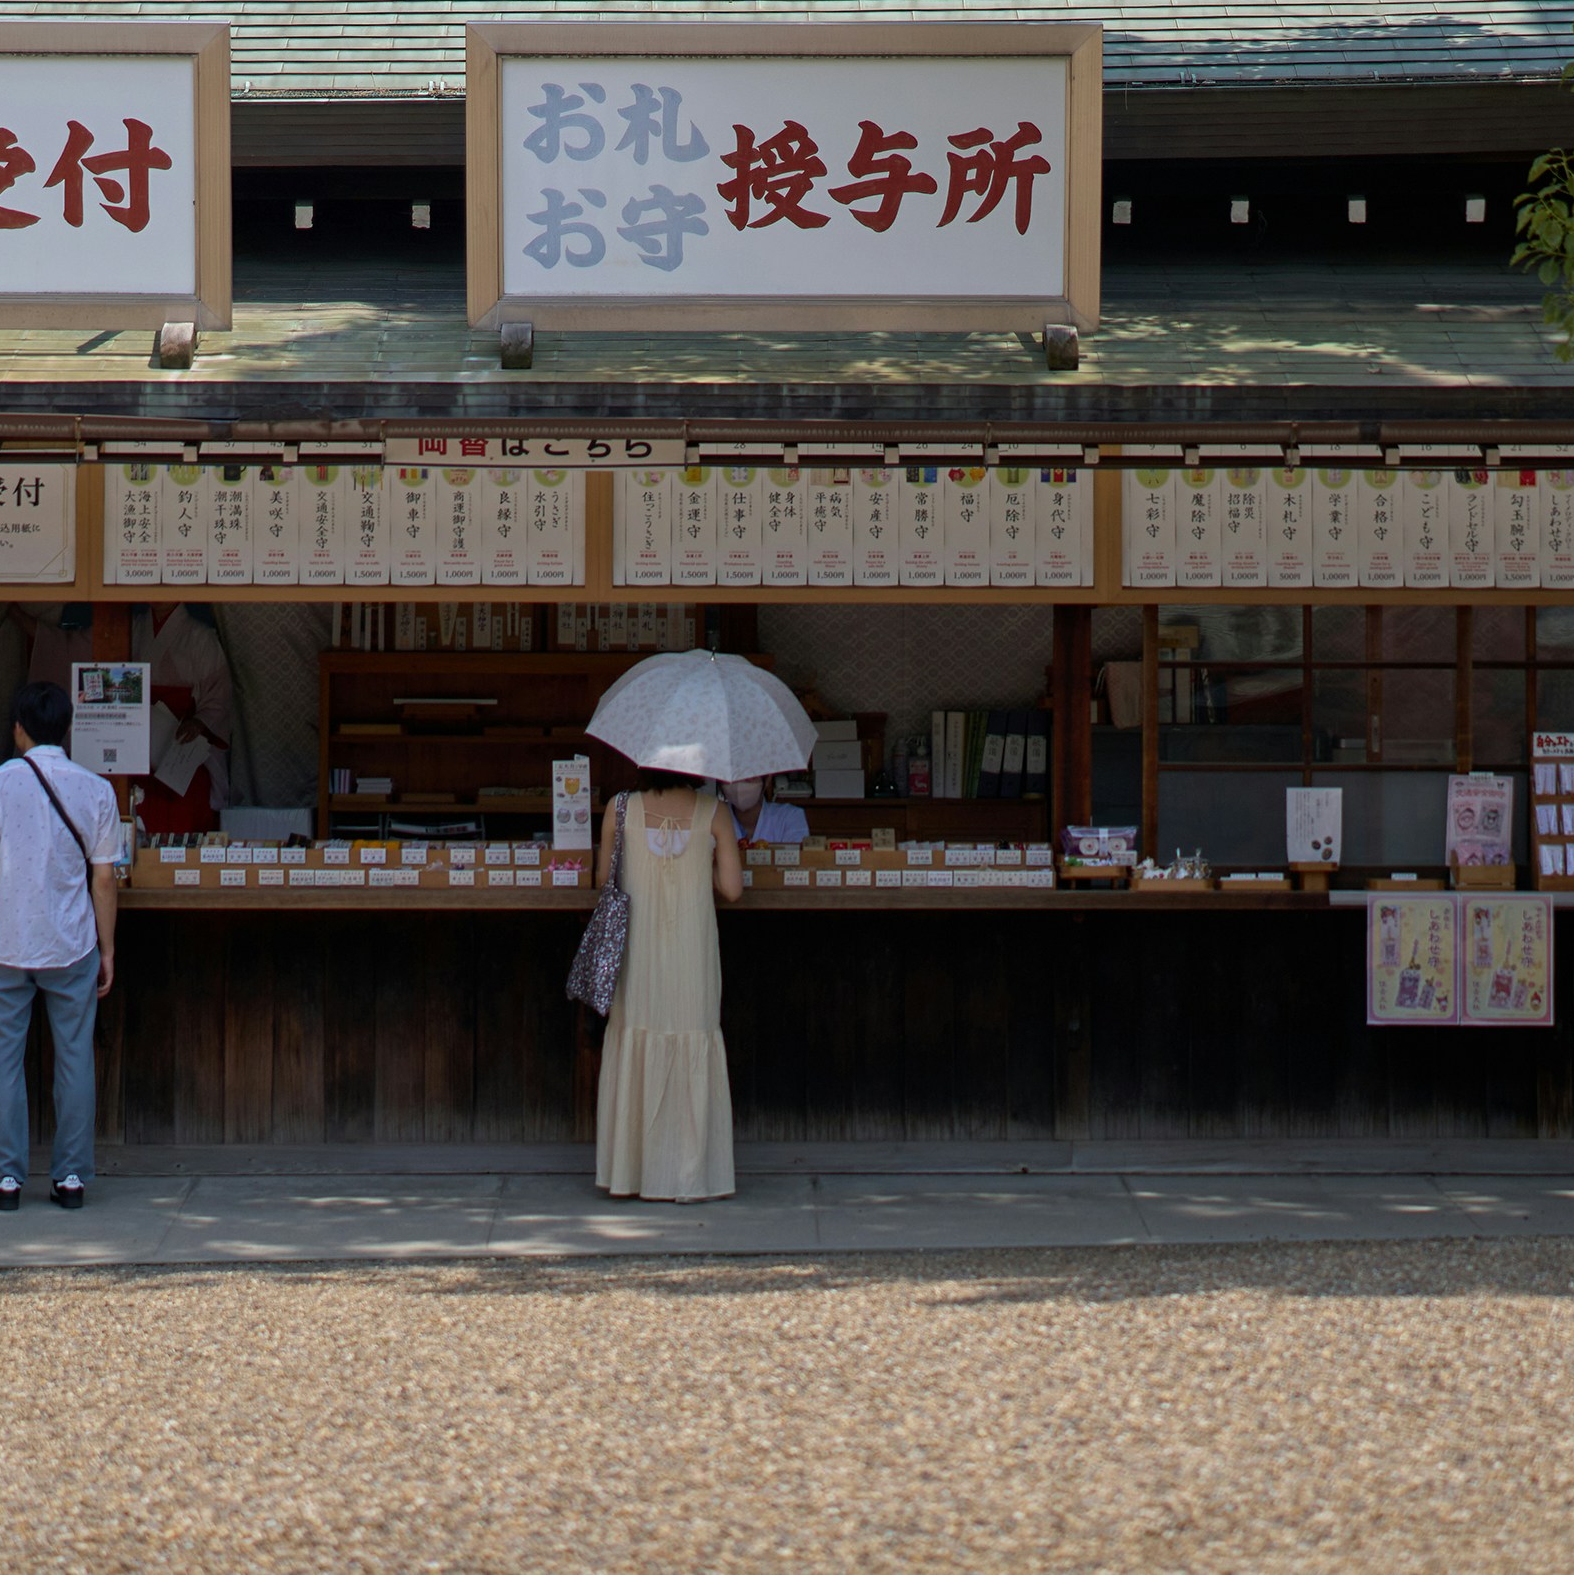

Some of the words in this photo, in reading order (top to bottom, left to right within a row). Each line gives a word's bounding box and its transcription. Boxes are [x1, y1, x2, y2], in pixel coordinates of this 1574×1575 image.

[522, 81, 710, 168] お札
[718, 119, 1051, 236] 授与所
[522, 183, 710, 272] お守
[123, 490, 136, 543] 大漁御守
[138, 490, 152, 543] 海上安全
[178, 490, 192, 537] 釣人守
[229, 490, 242, 530] 潮満珠
[269, 490, 283, 538] 美咲守
[316, 490, 328, 549] 交通安全守
[405, 491, 421, 538] 御車守
[497, 491, 512, 538] 良縁守
[534, 491, 546, 532] 水引守
[551, 491, 561, 529] うさぎ
[687, 491, 702, 539] 金運守
[732, 492, 747, 539] 仕事守
[769, 492, 782, 533] 健全守
[783, 492, 796, 518] 身体
[814, 492, 827, 533] 平癒守
[829, 492, 843, 518] 病気
[868, 492, 884, 539] 安産守
[914, 492, 929, 539] 常勝守
[960, 492, 975, 523] 福守
[1005, 493, 1020, 540] 厄除守
[1050, 493, 1065, 540] 身代守
[1145, 493, 1160, 538] 七彩守
[1191, 493, 1206, 540] 魔除守
[1228, 493, 1240, 533] 招福守
[1242, 493, 1256, 520] 除災
[1282, 493, 1297, 541] 木札守
[1328, 493, 1343, 541] 学業守
[1374, 494, 1388, 541] 合格守
[1420, 494, 1434, 549] こども守
[1548, 494, 1563, 552] しあわせ守
